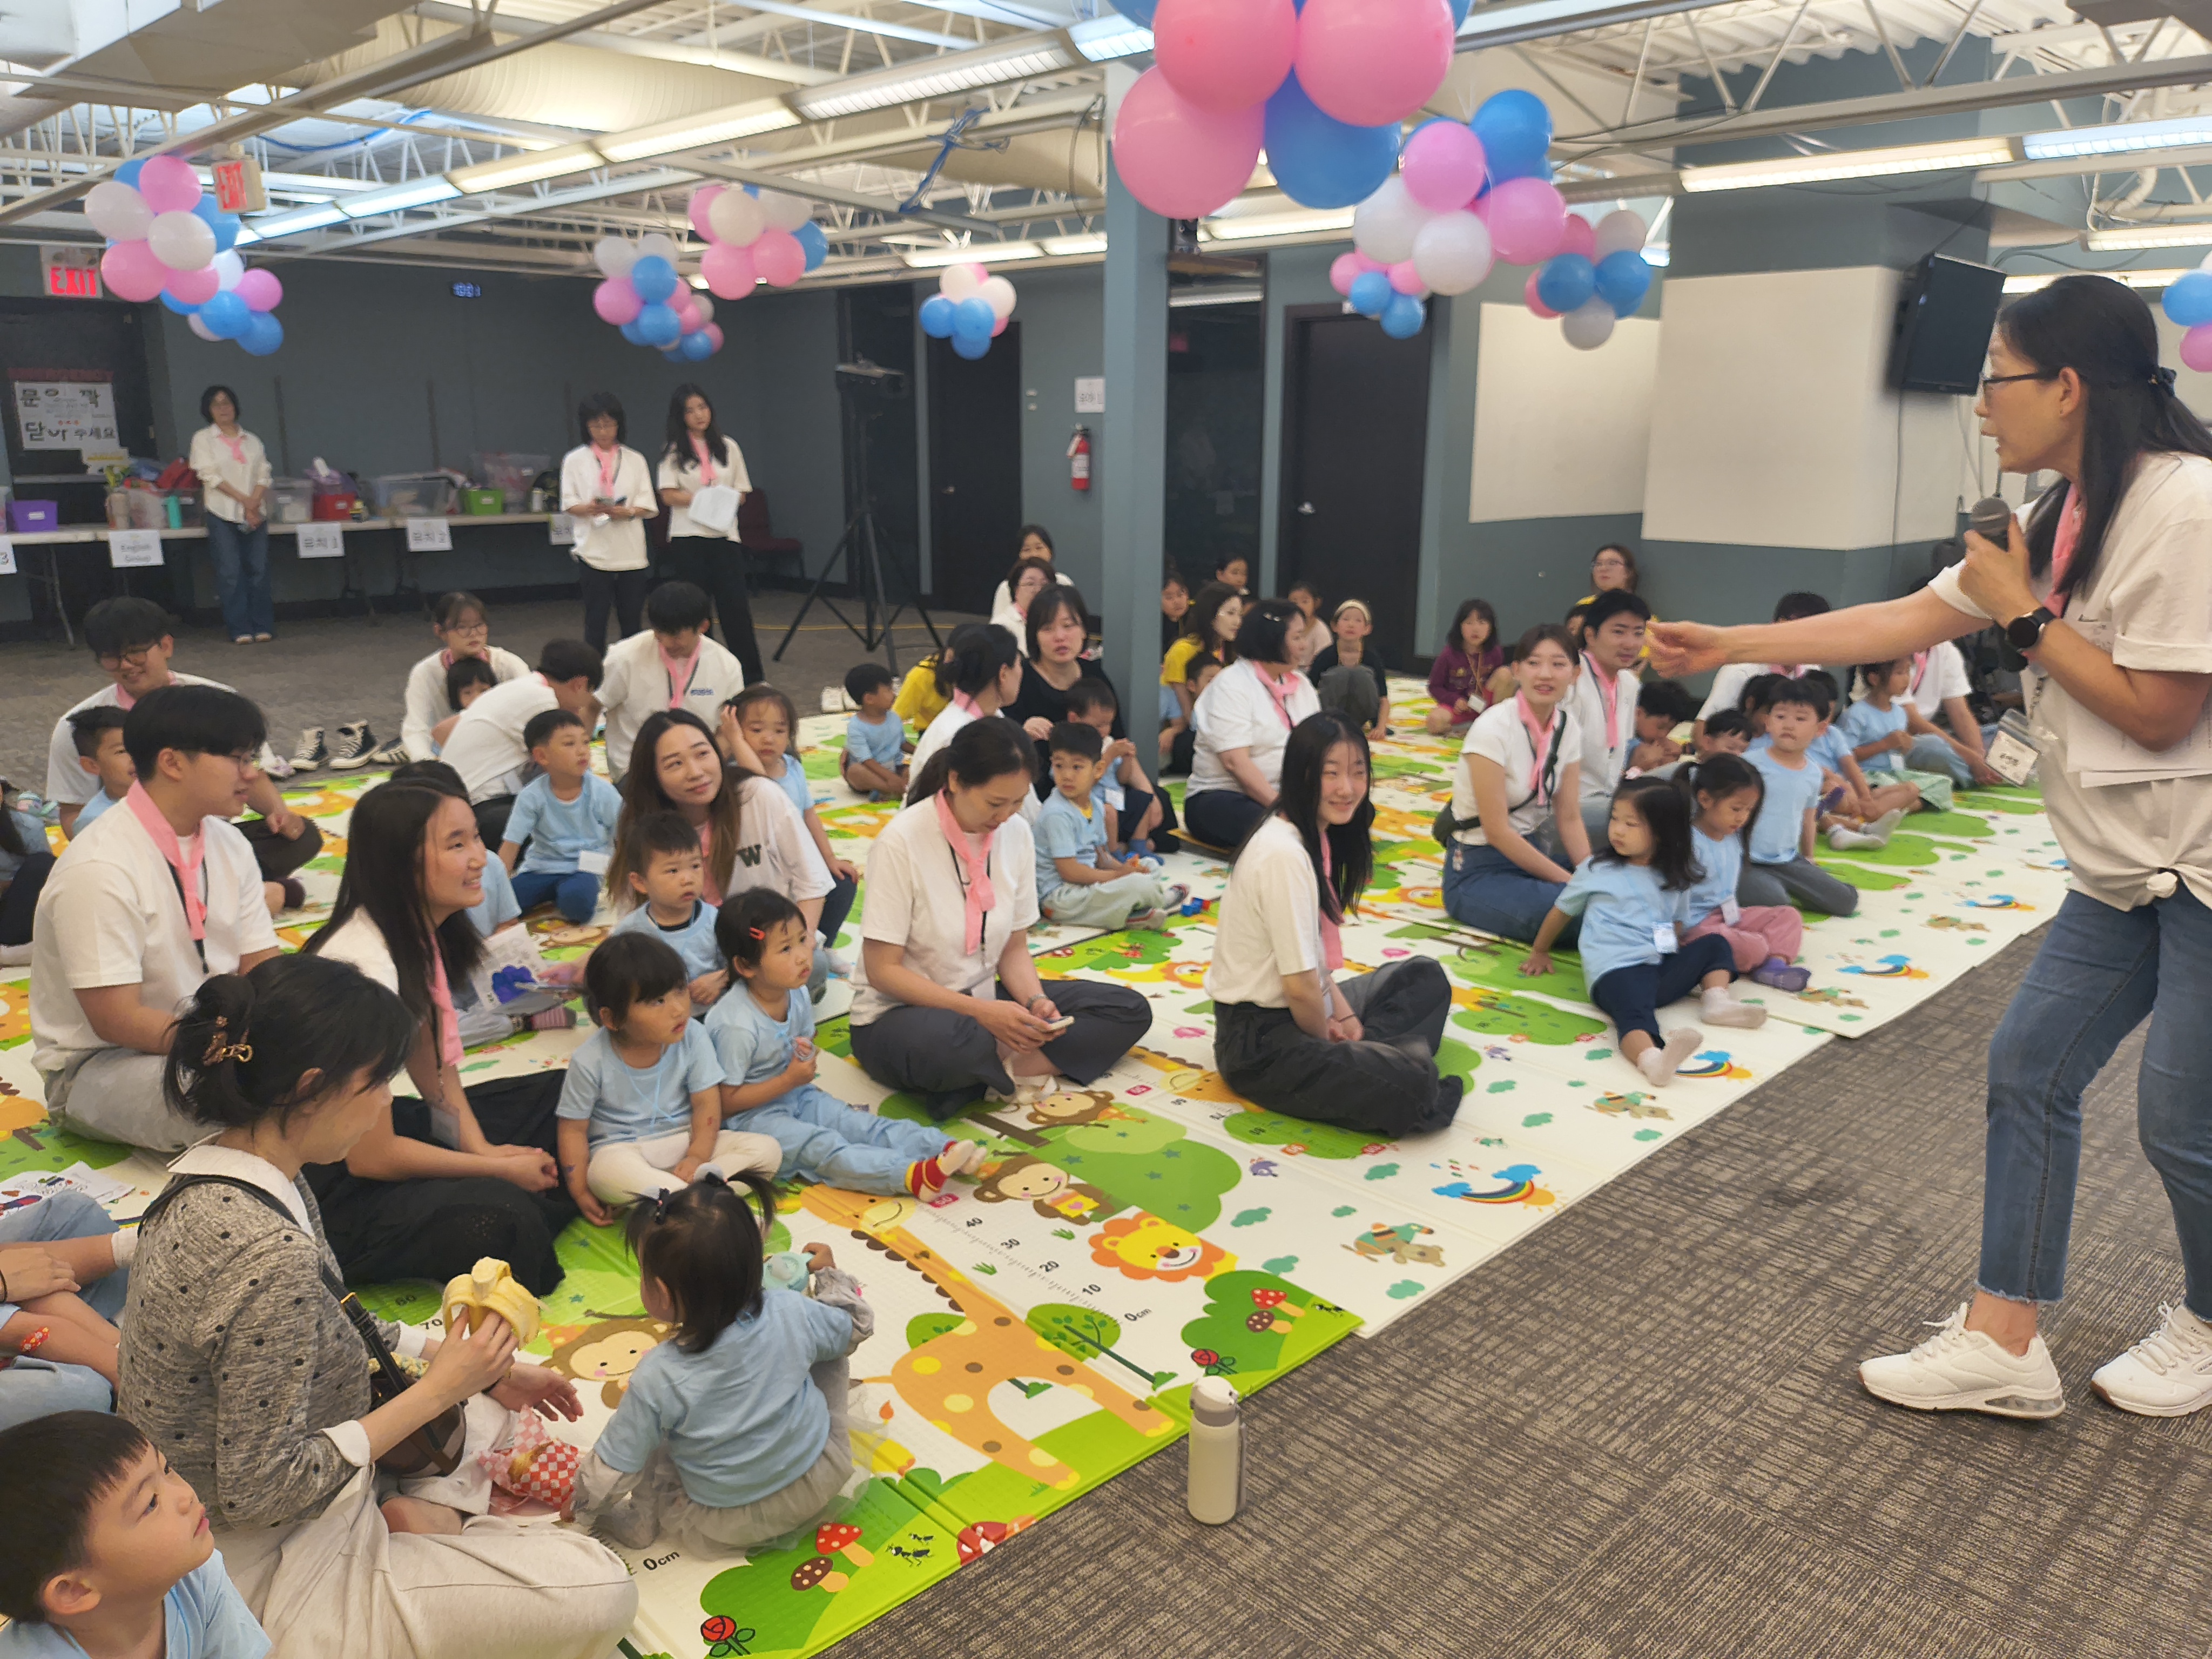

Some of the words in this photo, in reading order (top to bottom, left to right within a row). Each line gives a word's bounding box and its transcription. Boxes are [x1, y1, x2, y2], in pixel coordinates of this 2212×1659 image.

[50, 266, 96, 297] EXIT
[737, 844, 761, 867] W
[966, 1217, 983, 1228] 40
[1001, 1238, 1020, 1249] 30
[1039, 1260, 1060, 1272] 20
[1082, 1284, 1102, 1295] 10
[643, 1551, 680, 1571] 0cm
